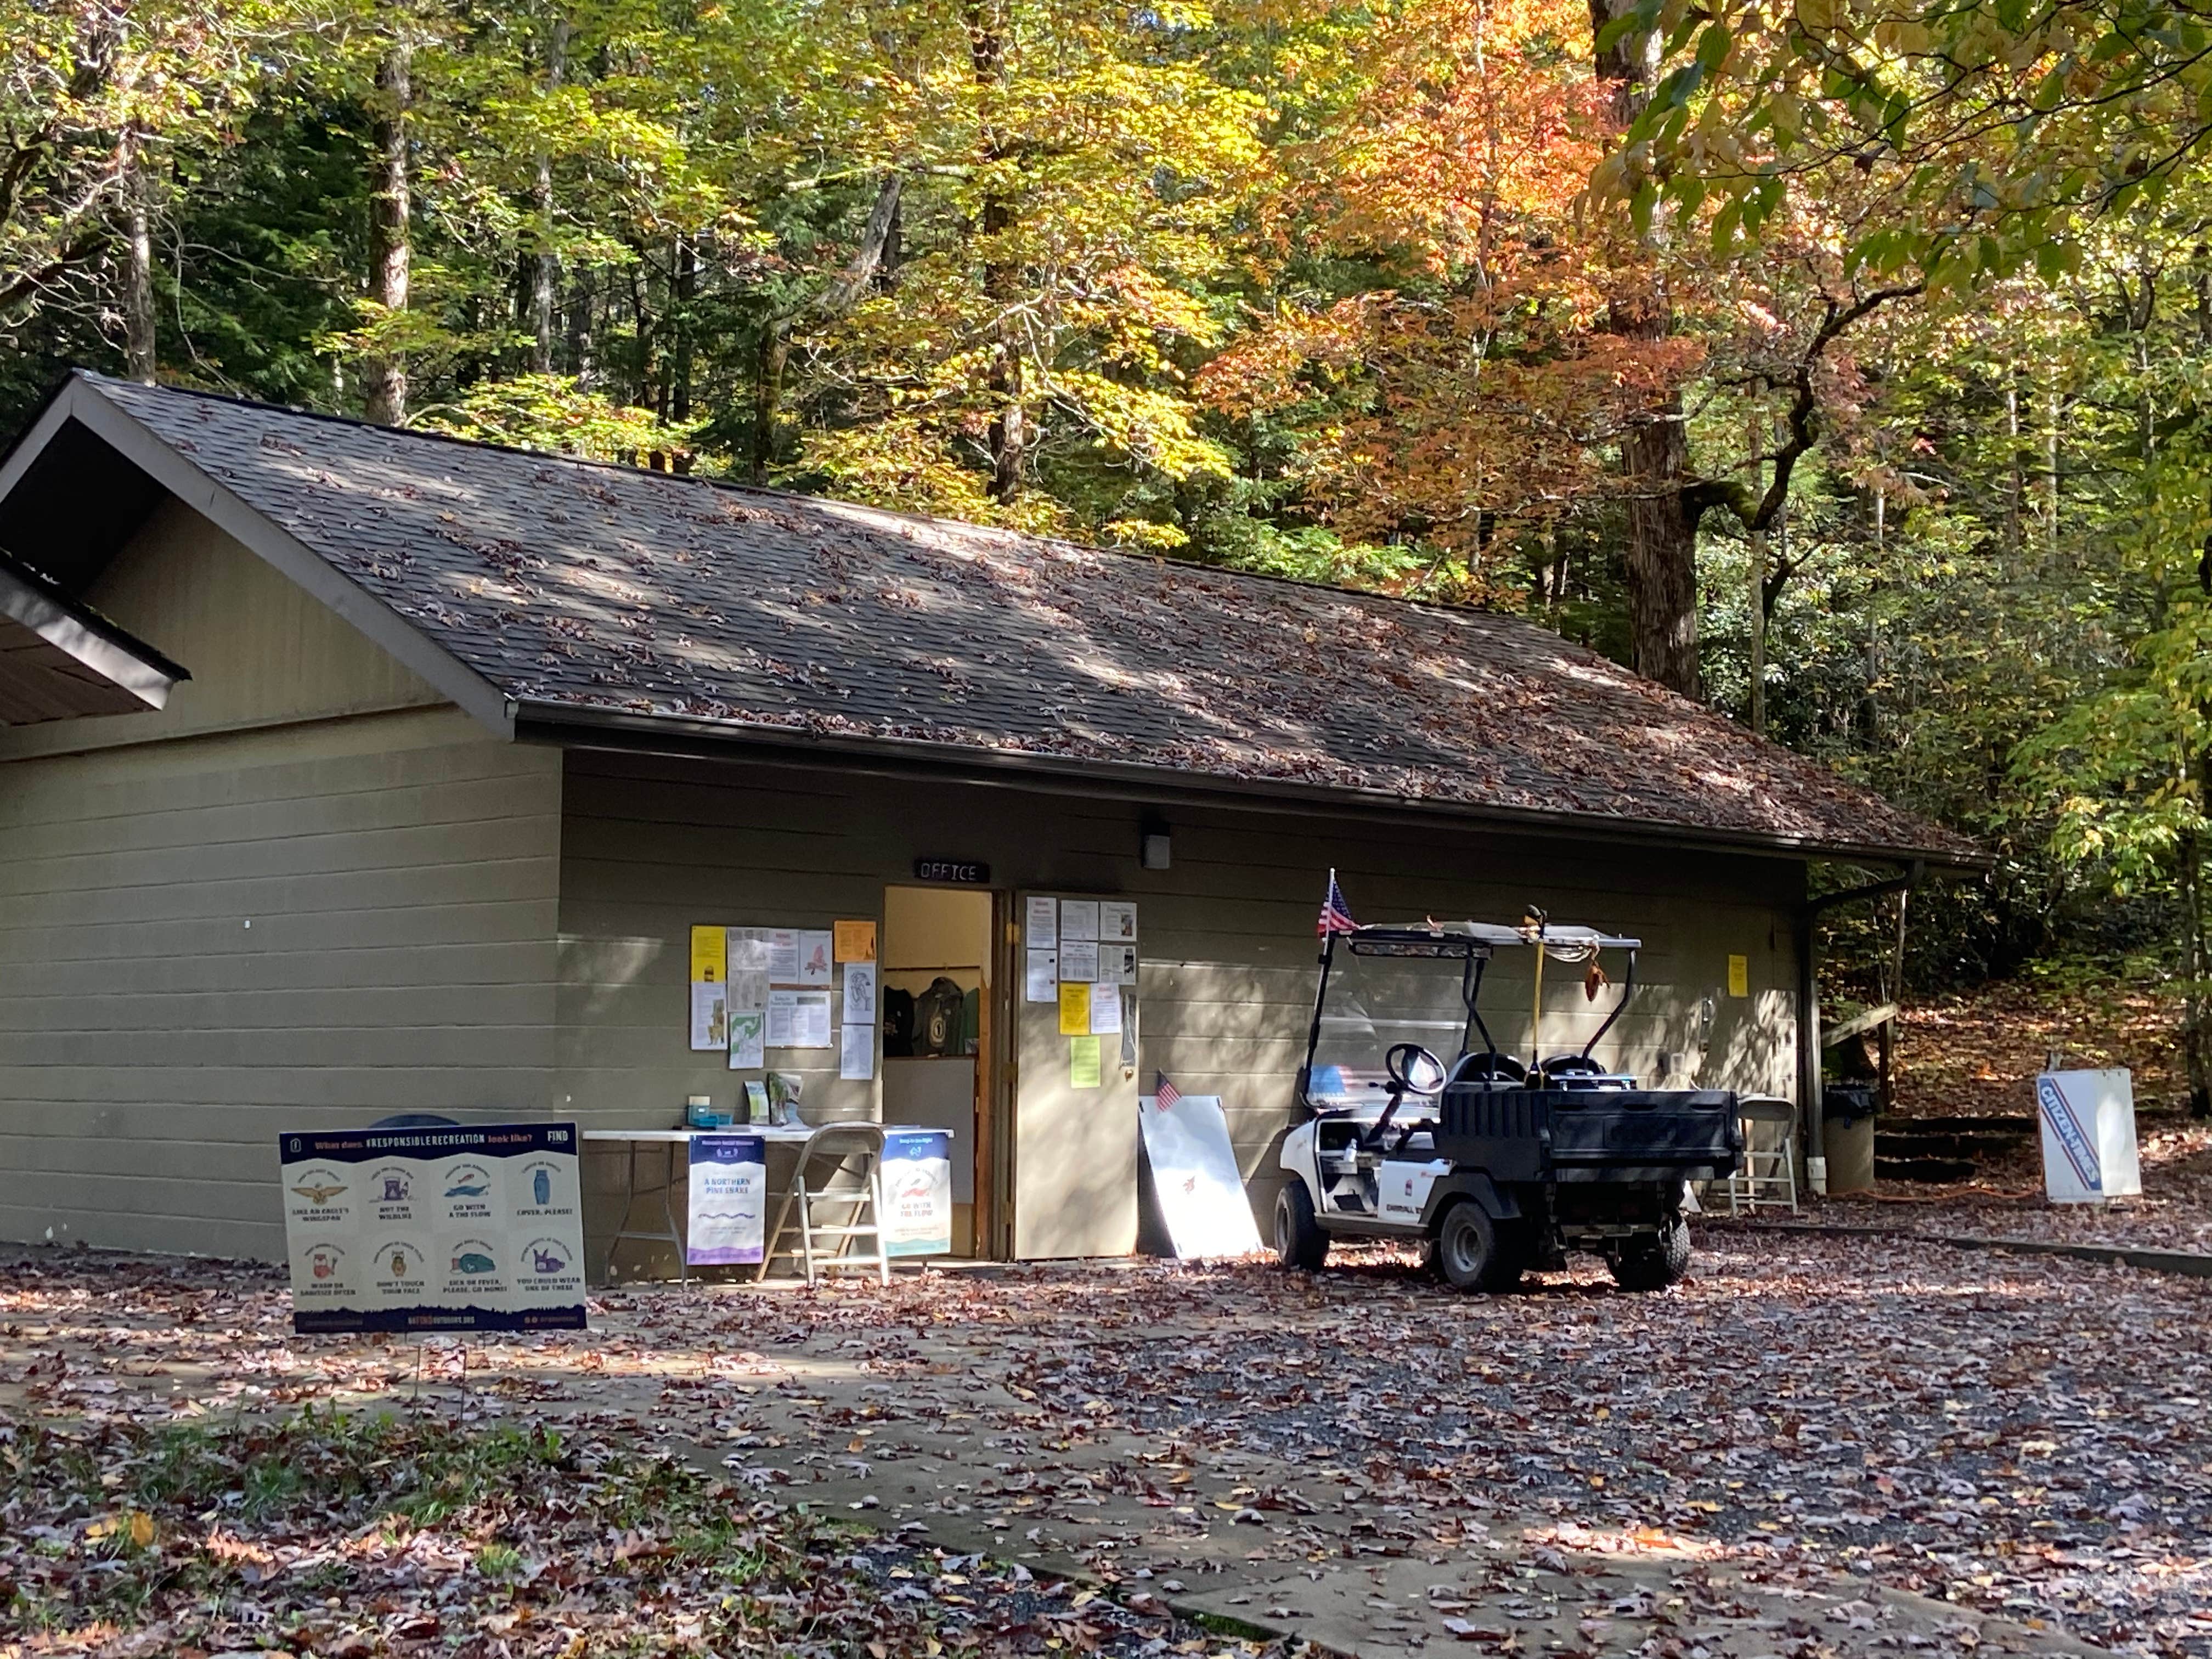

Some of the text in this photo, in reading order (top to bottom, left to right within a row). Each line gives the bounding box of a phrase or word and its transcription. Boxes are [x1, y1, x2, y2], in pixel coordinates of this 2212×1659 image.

[921, 862, 976, 881] OFFICE
[510, 1133, 532, 1142] like?
[547, 1130, 568, 1142] FIND
